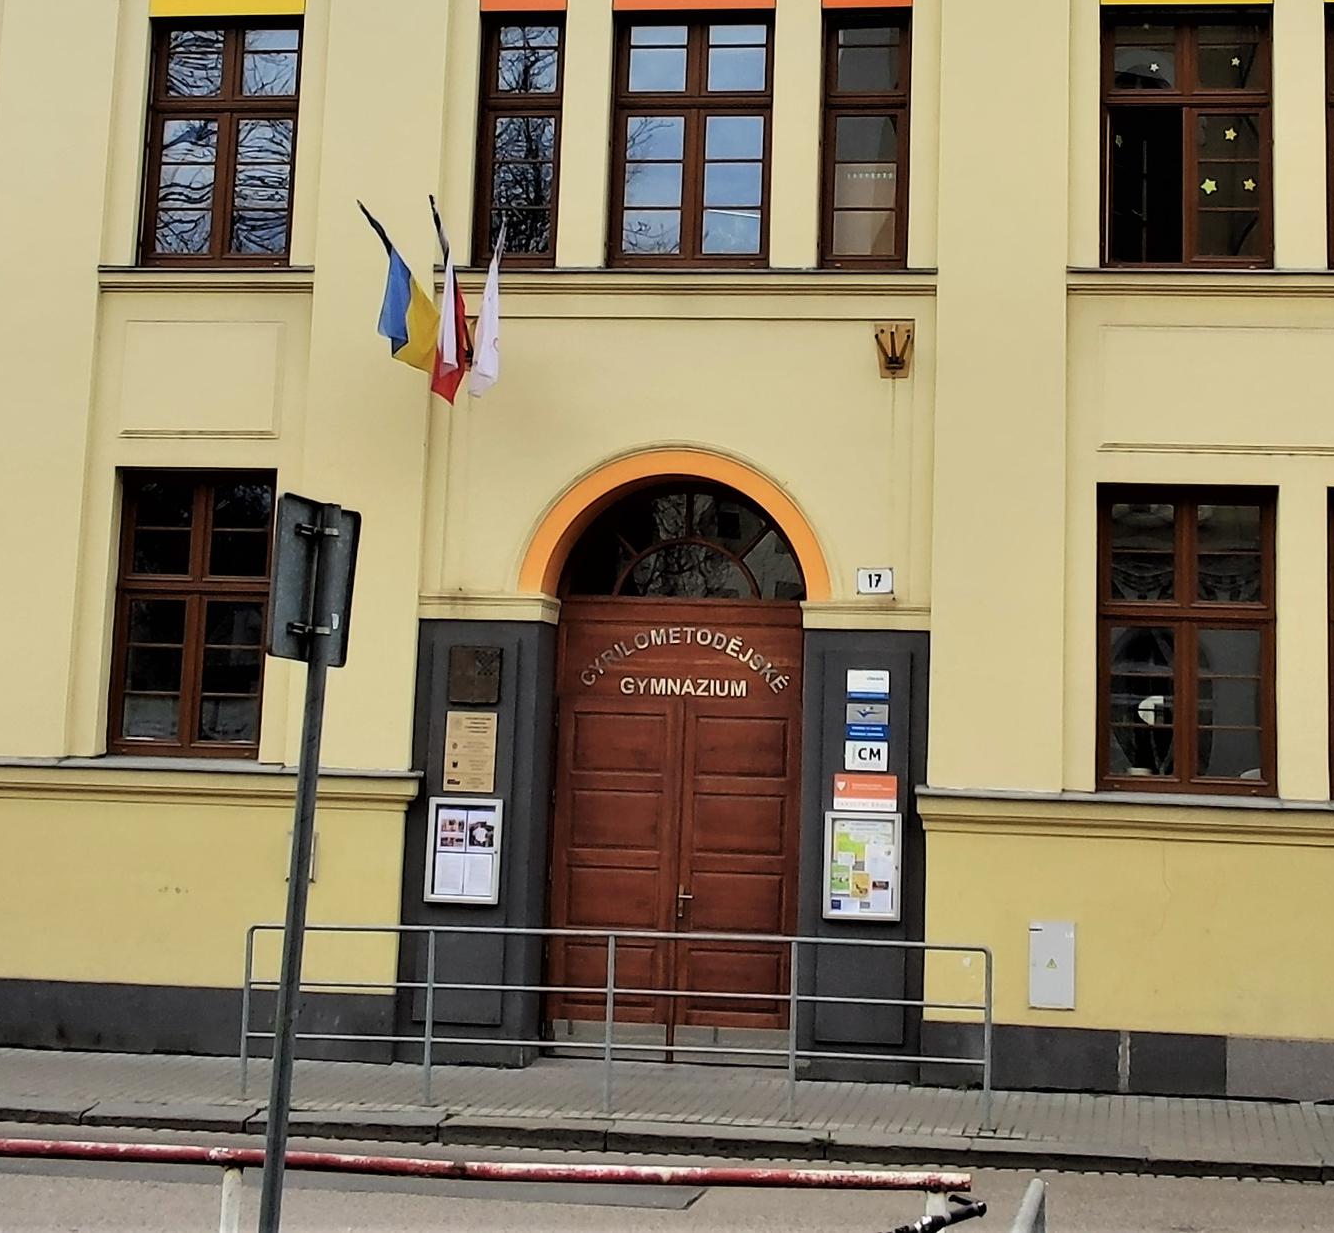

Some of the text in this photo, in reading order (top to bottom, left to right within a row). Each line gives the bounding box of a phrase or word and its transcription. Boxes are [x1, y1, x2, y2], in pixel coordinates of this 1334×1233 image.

[868, 573, 882, 588] 17
[580, 627, 790, 694] CYRILOMETODĚJSKÉ
[620, 674, 747, 697] GYMNÁZIUM
[858, 747, 881, 761] CM
